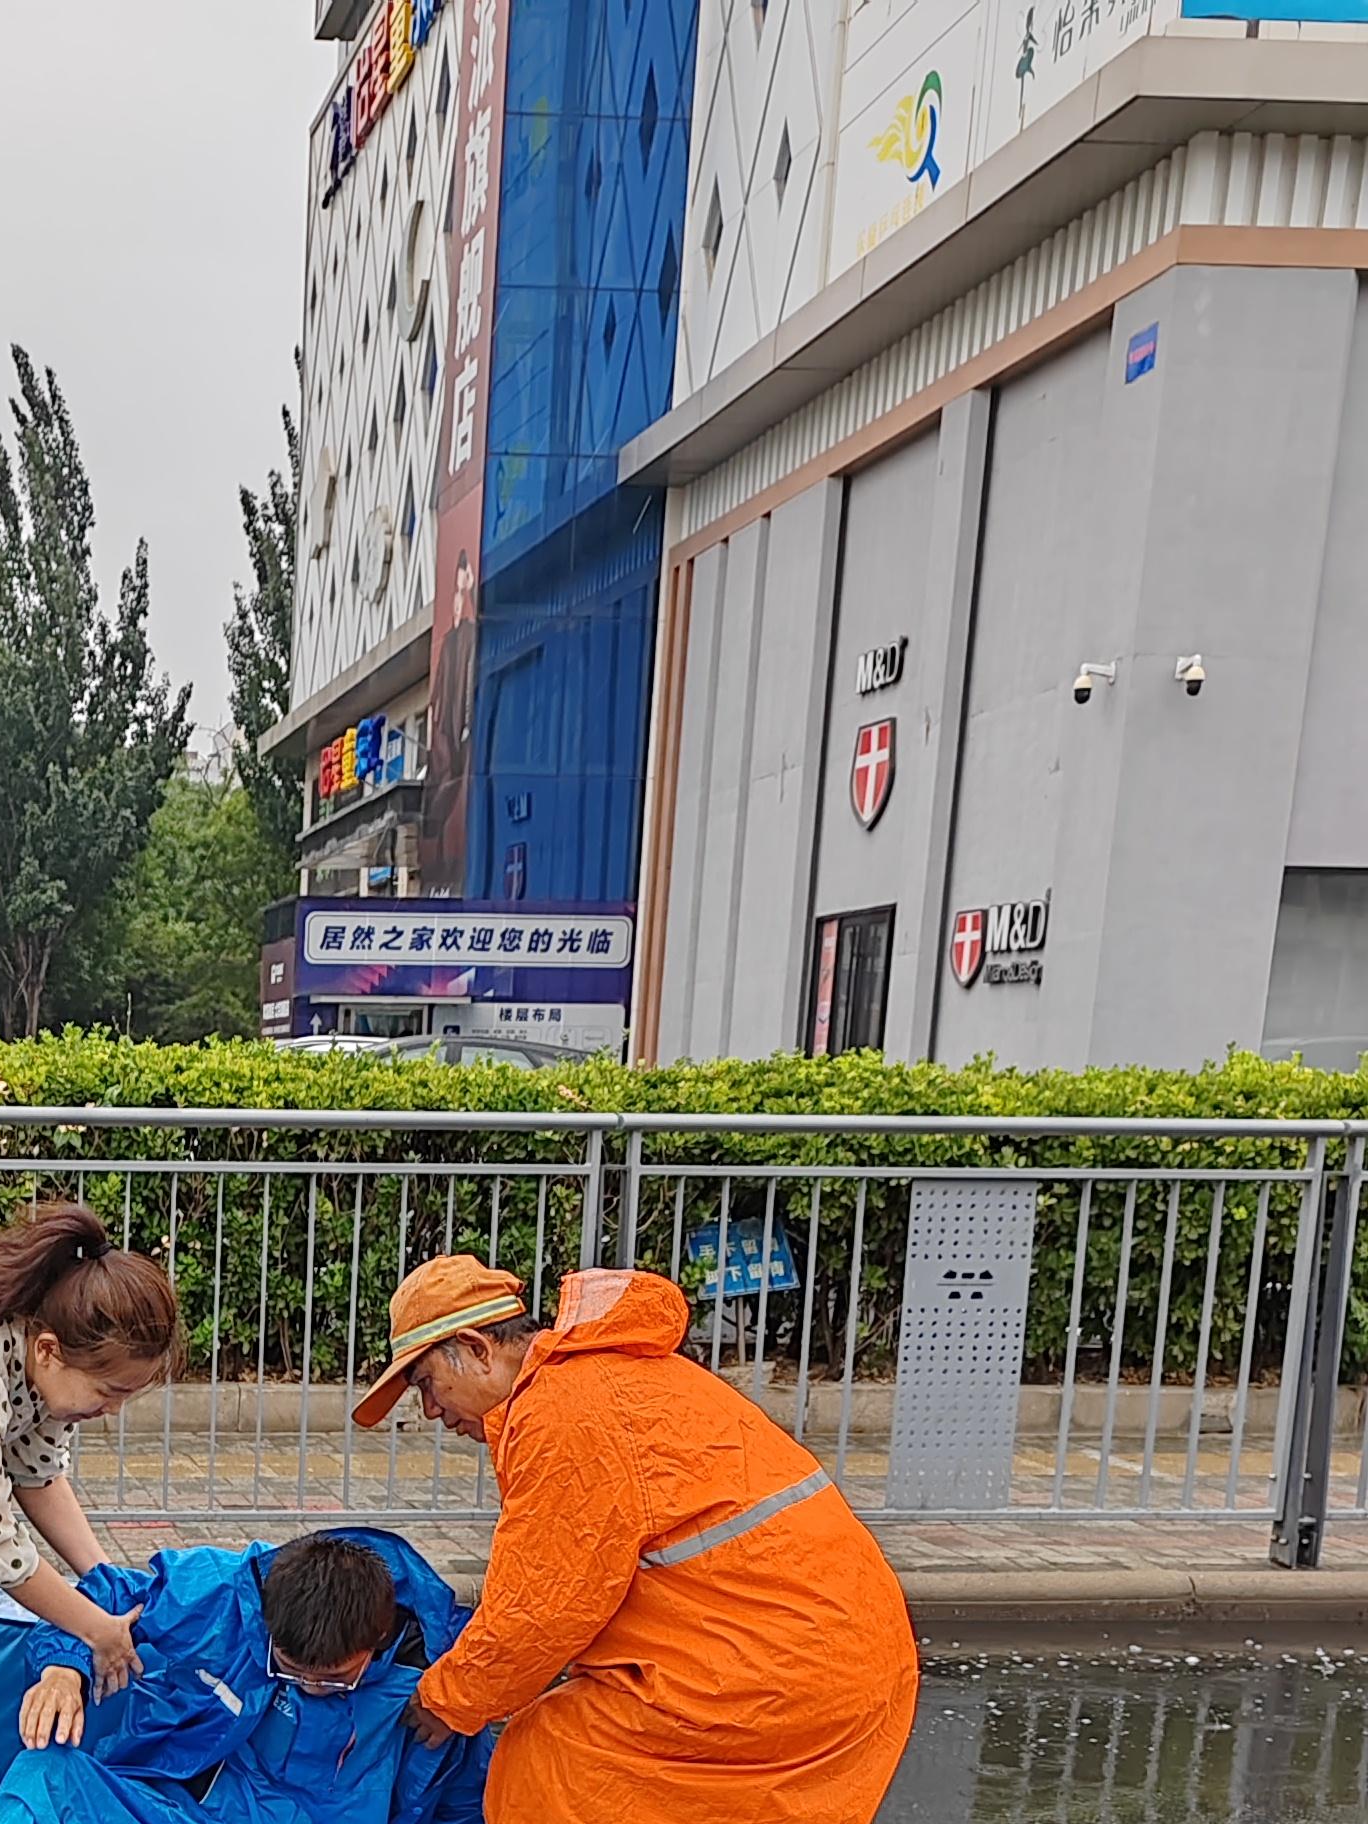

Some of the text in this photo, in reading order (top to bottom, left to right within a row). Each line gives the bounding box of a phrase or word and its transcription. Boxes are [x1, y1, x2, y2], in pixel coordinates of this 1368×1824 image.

[319, 925, 615, 954] 居然之家欢迎您的光临
[984, 899, 1047, 953] M&D
[499, 1007, 563, 1023] 楼层布局
